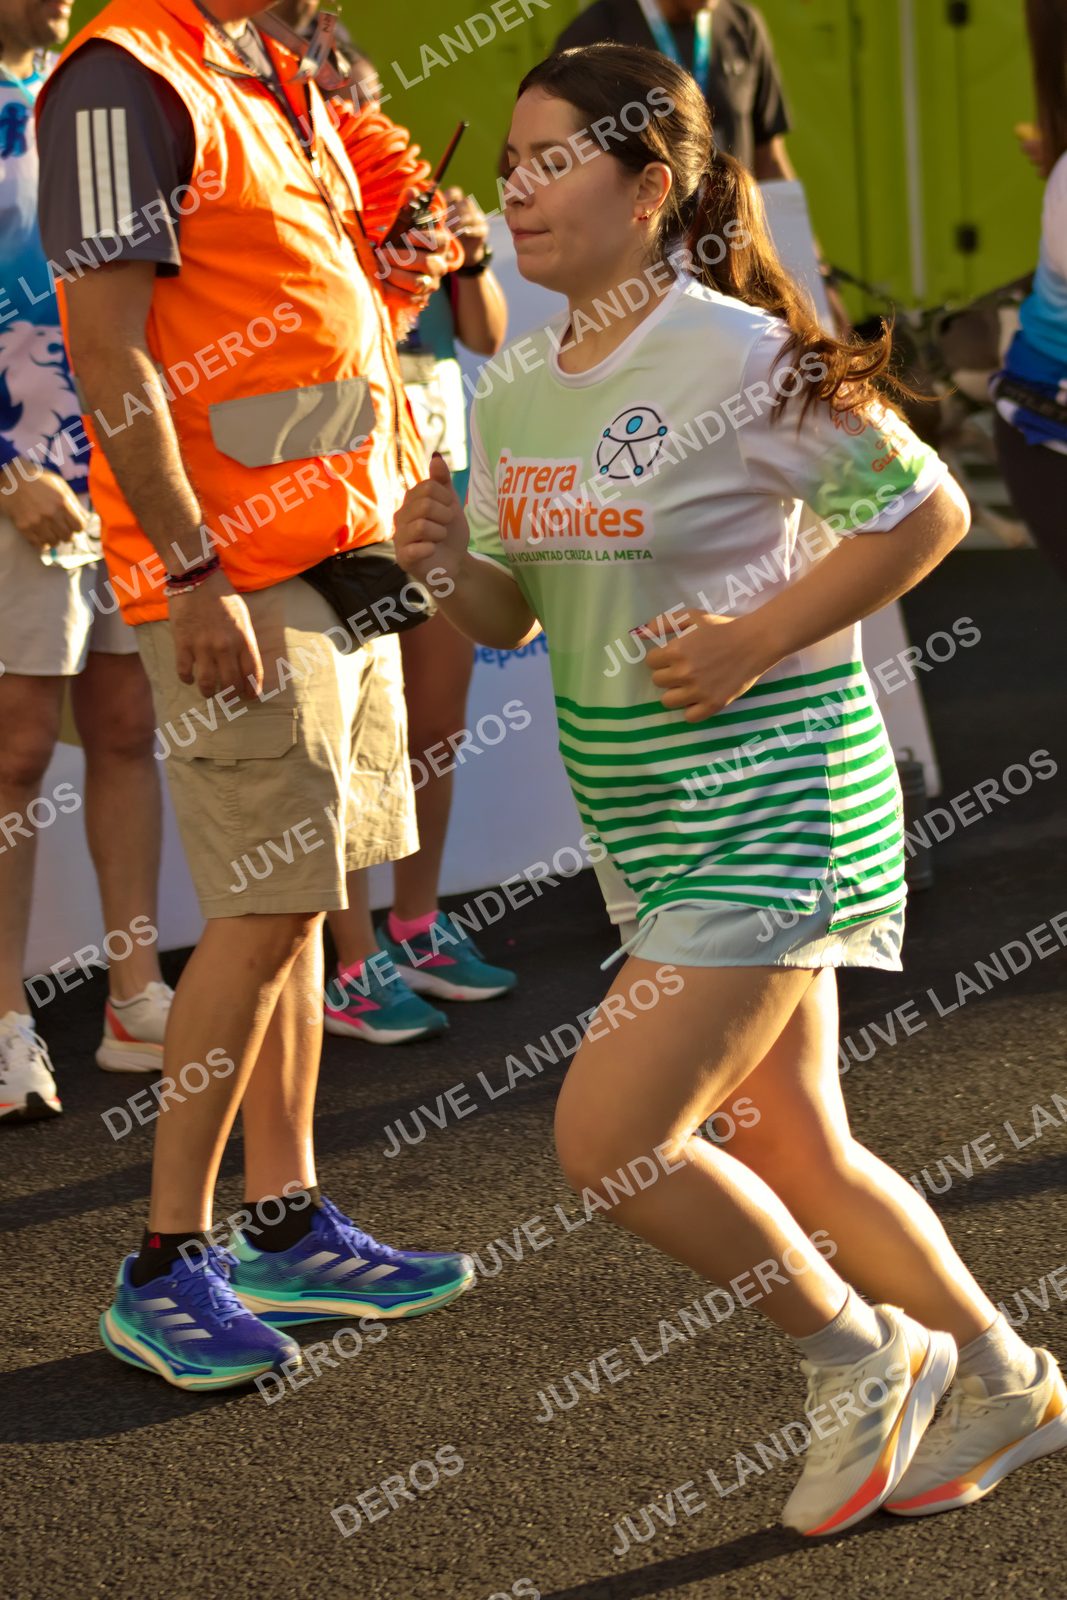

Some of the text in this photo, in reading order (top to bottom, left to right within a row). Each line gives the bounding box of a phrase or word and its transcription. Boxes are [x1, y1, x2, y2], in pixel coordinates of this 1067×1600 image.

[517, 550, 563, 562] VOLUNTAD
[564, 550, 592, 561] CRUZA
[595, 550, 611, 561] LA
[614, 549, 653, 561] META
